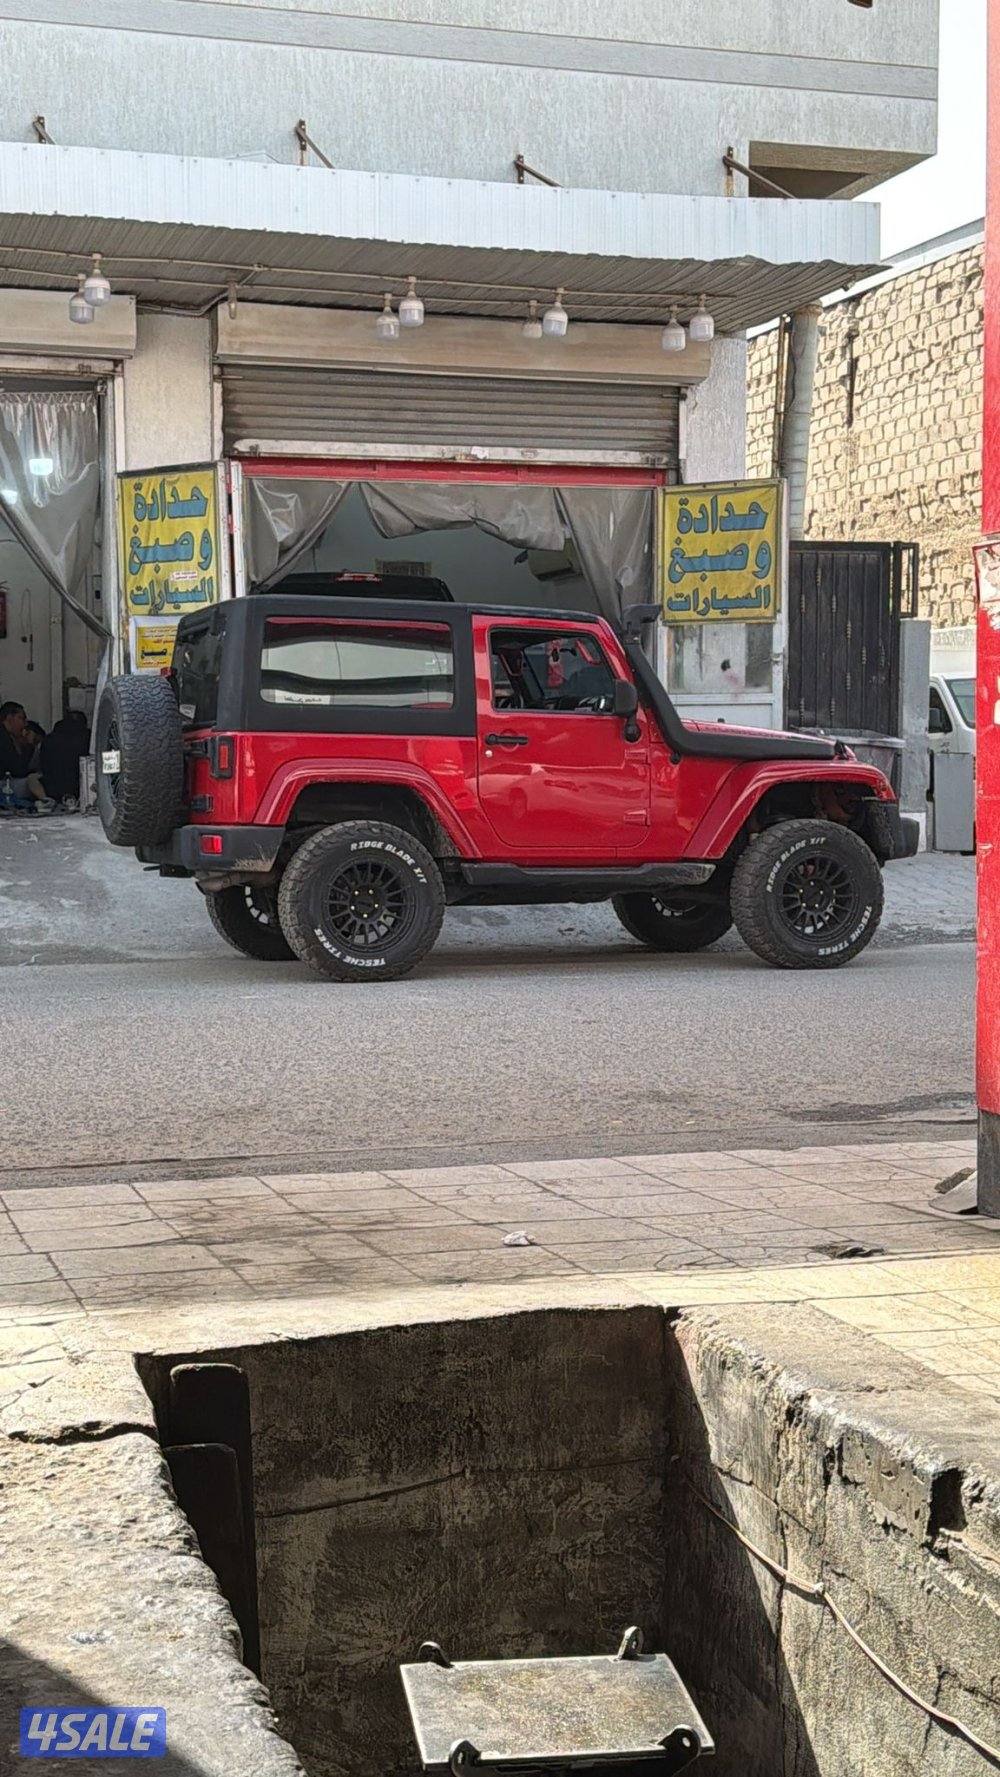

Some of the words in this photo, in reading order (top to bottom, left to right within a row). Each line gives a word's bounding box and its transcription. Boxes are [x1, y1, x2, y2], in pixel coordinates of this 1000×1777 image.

[133, 478, 208, 523] حدادة
[677, 495, 768, 534] حدادة
[130, 577, 214, 611] السيارات
[666, 584, 771, 617] السيارات
[350, 840, 384, 851] RIDGE
[385, 844, 416, 866] BLADE
[780, 839, 806, 862] BLADE
